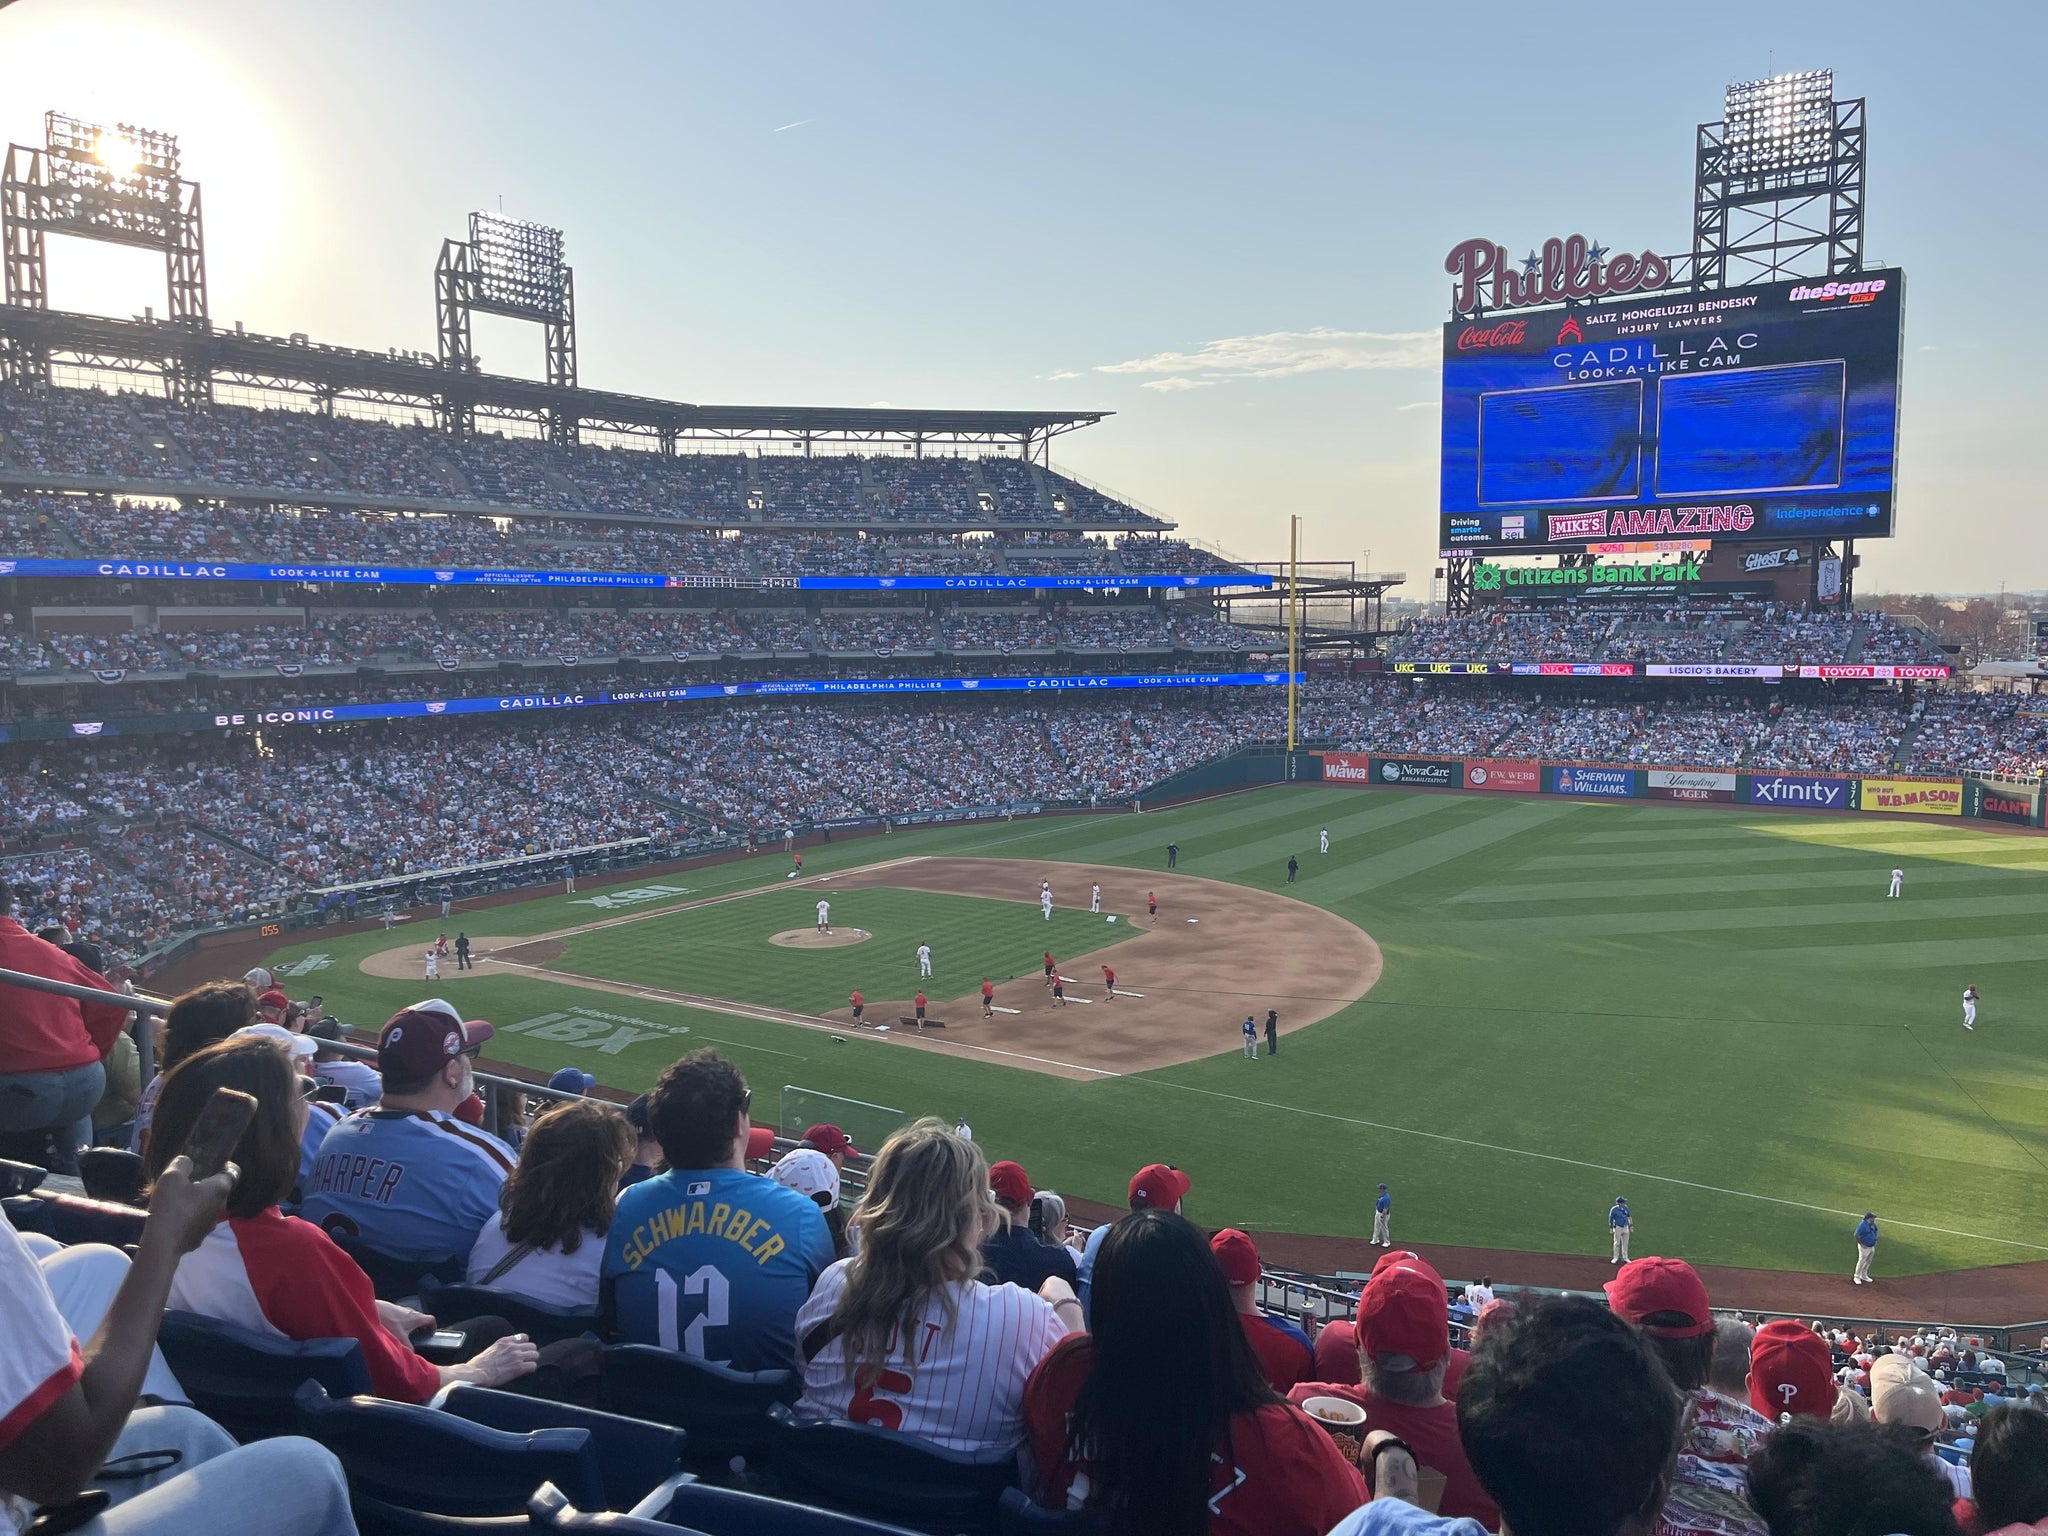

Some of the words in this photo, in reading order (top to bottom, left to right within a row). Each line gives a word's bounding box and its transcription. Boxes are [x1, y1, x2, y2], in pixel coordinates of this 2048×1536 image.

[1444, 233, 1669, 314] Phillies
[1789, 280, 1886, 301] theScore
[1586, 313, 1617, 325] SALTZ
[1622, 304, 1693, 321] MONGELUZZI
[1698, 296, 1758, 312] BENDESKY
[1617, 322, 1660, 335] INJURY
[1668, 315, 1722, 329] LAWYERS
[1553, 333, 1758, 367] CADILLAC
[1568, 360, 1689, 380] LOOK-A-LIKE
[1699, 354, 1741, 368] CAM
[1777, 506, 1863, 519] Independence
[1450, 518, 1480, 527] Driving
[1555, 517, 1601, 534] MIKE'S
[1609, 504, 1754, 536] AMAZING
[1450, 526, 1481, 534] smarter
[1450, 534, 1492, 542] outcomes.
[1745, 549, 1789, 571] GHOST
[99, 564, 226, 577] CADILLAC
[270, 568, 350, 578] LOOK-A-LIKE
[355, 570, 380, 579] CAM
[1505, 566, 1587, 585] Citizens
[1592, 560, 1647, 583] Bank
[1650, 560, 1700, 582] Park
[549, 575, 613, 584] PHILADELPHIA
[616, 576, 654, 584] PHILLIES
[945, 579, 1027, 587] CADILLAC
[1394, 663, 1415, 673] UKG
[1429, 663, 1451, 673] UKG
[1466, 664, 1488, 673] UKG
[1543, 665, 1569, 674] NECA
[1604, 665, 1630, 674] NECA
[1669, 667, 1711, 675] LISCIO'S
[1716, 667, 1758, 675] BAKERY
[1823, 667, 1870, 676] TOYOTA
[1898, 668, 1946, 677] TOYOTA
[824, 682, 894, 690] PHILADELPHIA
[898, 681, 942, 689] PHILLIES
[1027, 678, 1109, 687] CADILLAC
[612, 690, 667, 700] LOOK-A-LIKE
[669, 689, 687, 697] CAM
[500, 695, 584, 709] CADILLAC
[215, 714, 245, 726] BE
[257, 709, 334, 724] ICONIC
[1325, 764, 1367, 779] Wawa
[1401, 764, 1450, 777] NovaCare
[1508, 771, 1535, 780] WEBB
[1575, 770, 1625, 783] SHERWIN
[1664, 773, 1718, 788] Yuengling
[1673, 789, 1708, 799] LAGER
[1756, 778, 1839, 804] xfinity
[1983, 797, 2031, 816] GIANT
[565, 1005, 669, 1030] Independence
[498, 1012, 671, 1055] IBX
[314, 1154, 404, 1205] HARPER
[622, 1201, 785, 1270] SCHWARBER
[654, 1264, 732, 1368] 12
[1777, 1383, 1799, 1405] P
